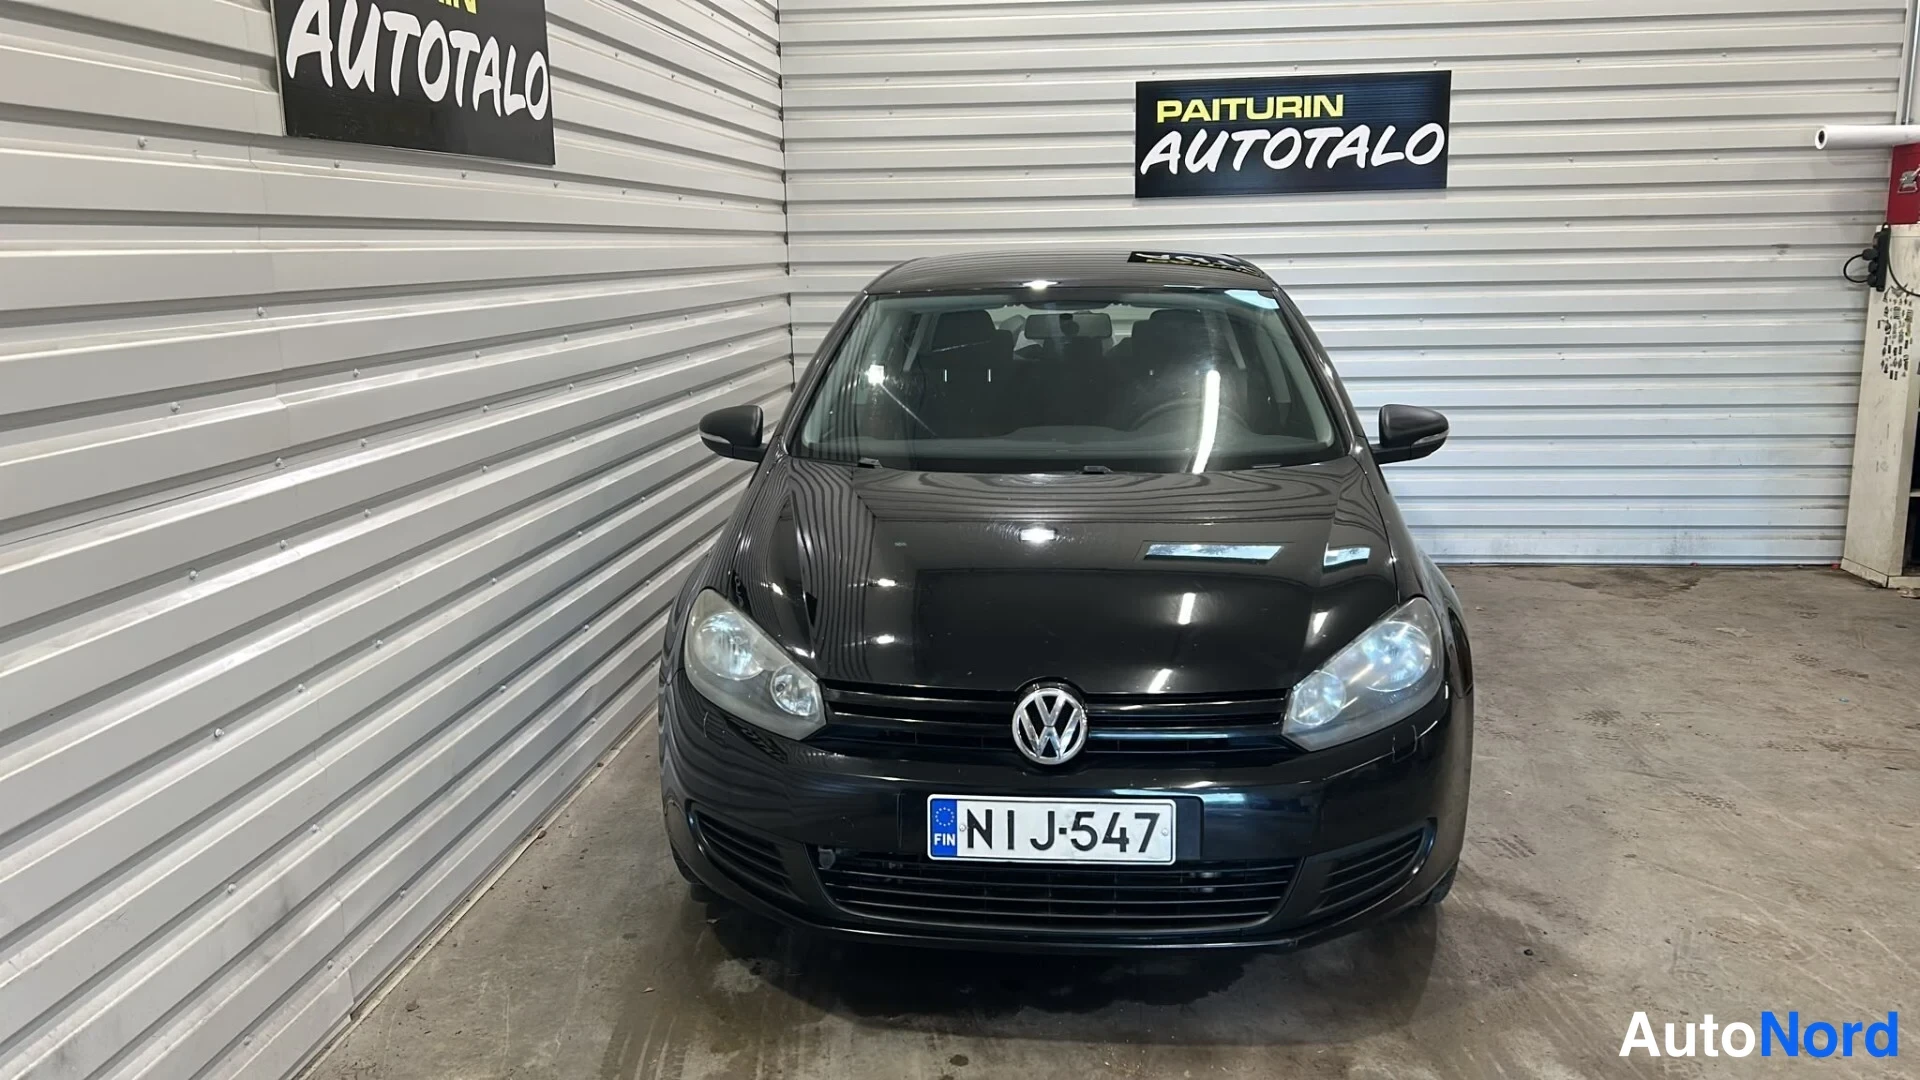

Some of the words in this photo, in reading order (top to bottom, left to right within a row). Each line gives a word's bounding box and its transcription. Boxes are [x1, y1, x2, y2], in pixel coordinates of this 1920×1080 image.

[286, 0, 549, 120] AUTOTALO
[1156, 94, 1343, 123] PAITURIN
[1140, 122, 1445, 175] AUTOTALO
[934, 833, 955, 846] FIN
[967, 808, 1160, 853] NIJ-547
